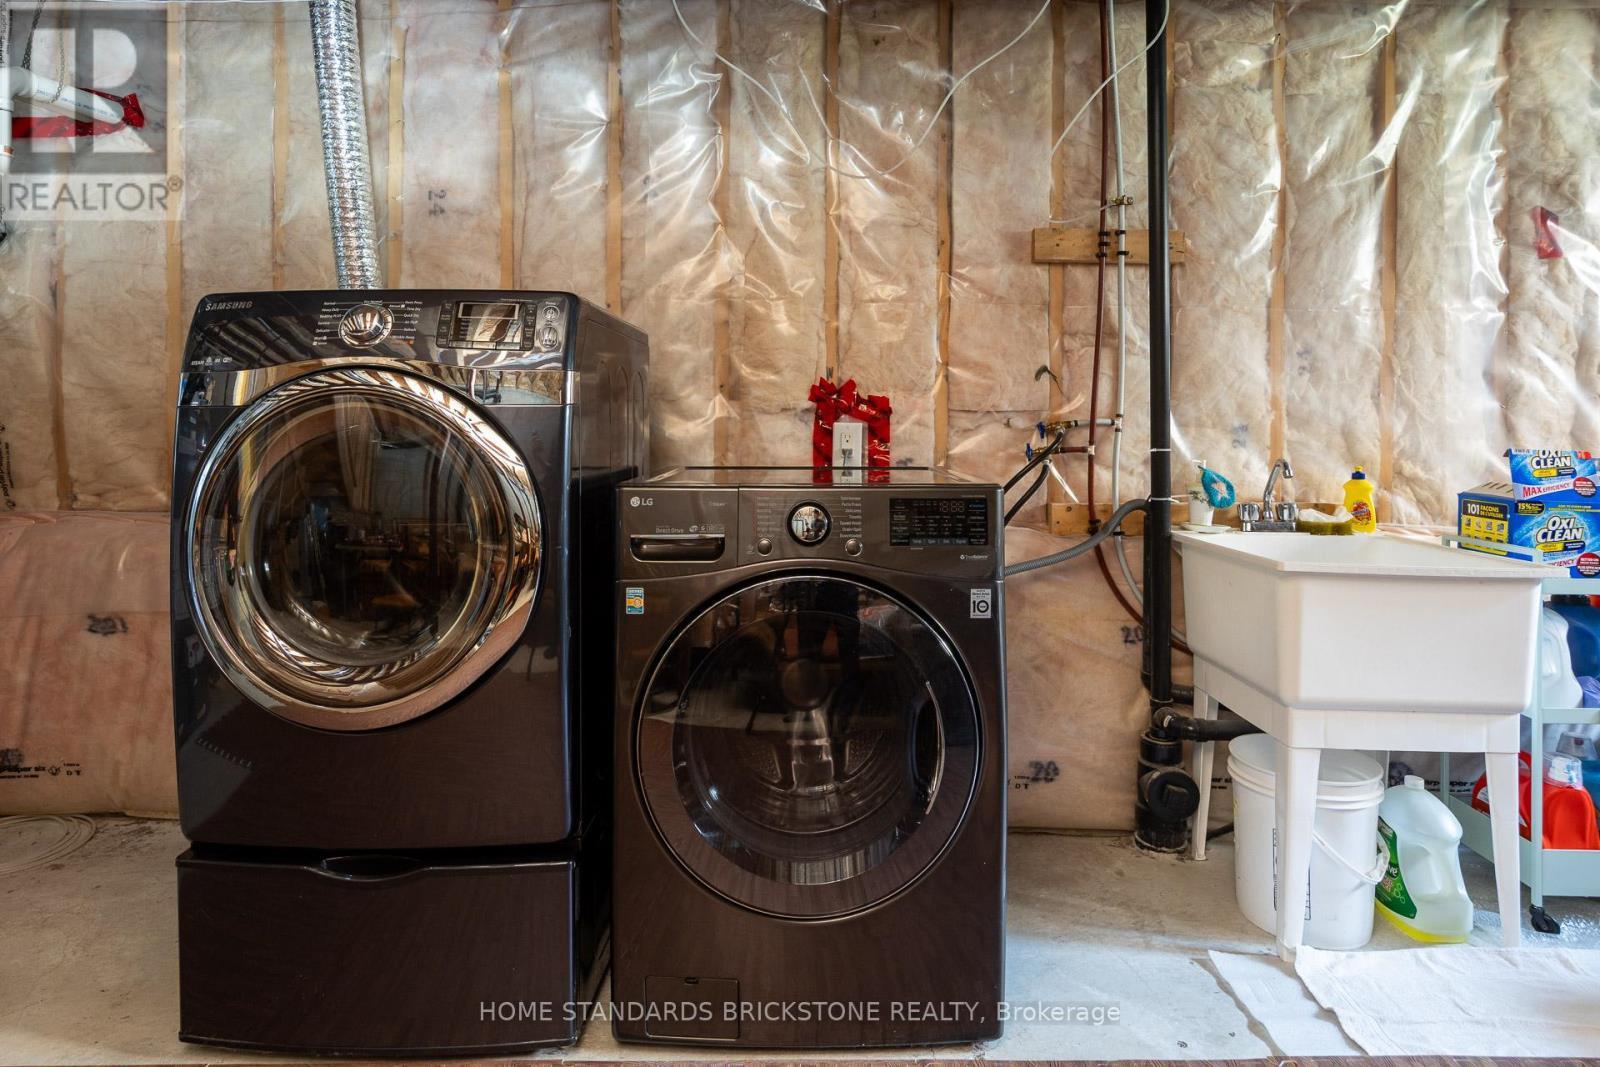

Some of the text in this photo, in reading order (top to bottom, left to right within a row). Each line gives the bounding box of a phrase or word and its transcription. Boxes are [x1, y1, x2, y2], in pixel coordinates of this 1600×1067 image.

[205, 301, 253, 311] SAMSUNG
[1531, 456, 1571, 469] CLEAN
[1522, 486, 1542, 498] MAX
[1467, 503, 1480, 515] 101
[1517, 502, 1532, 511] 15%
[1547, 515, 1576, 531] OXI
[1536, 527, 1584, 544] CLEAN
